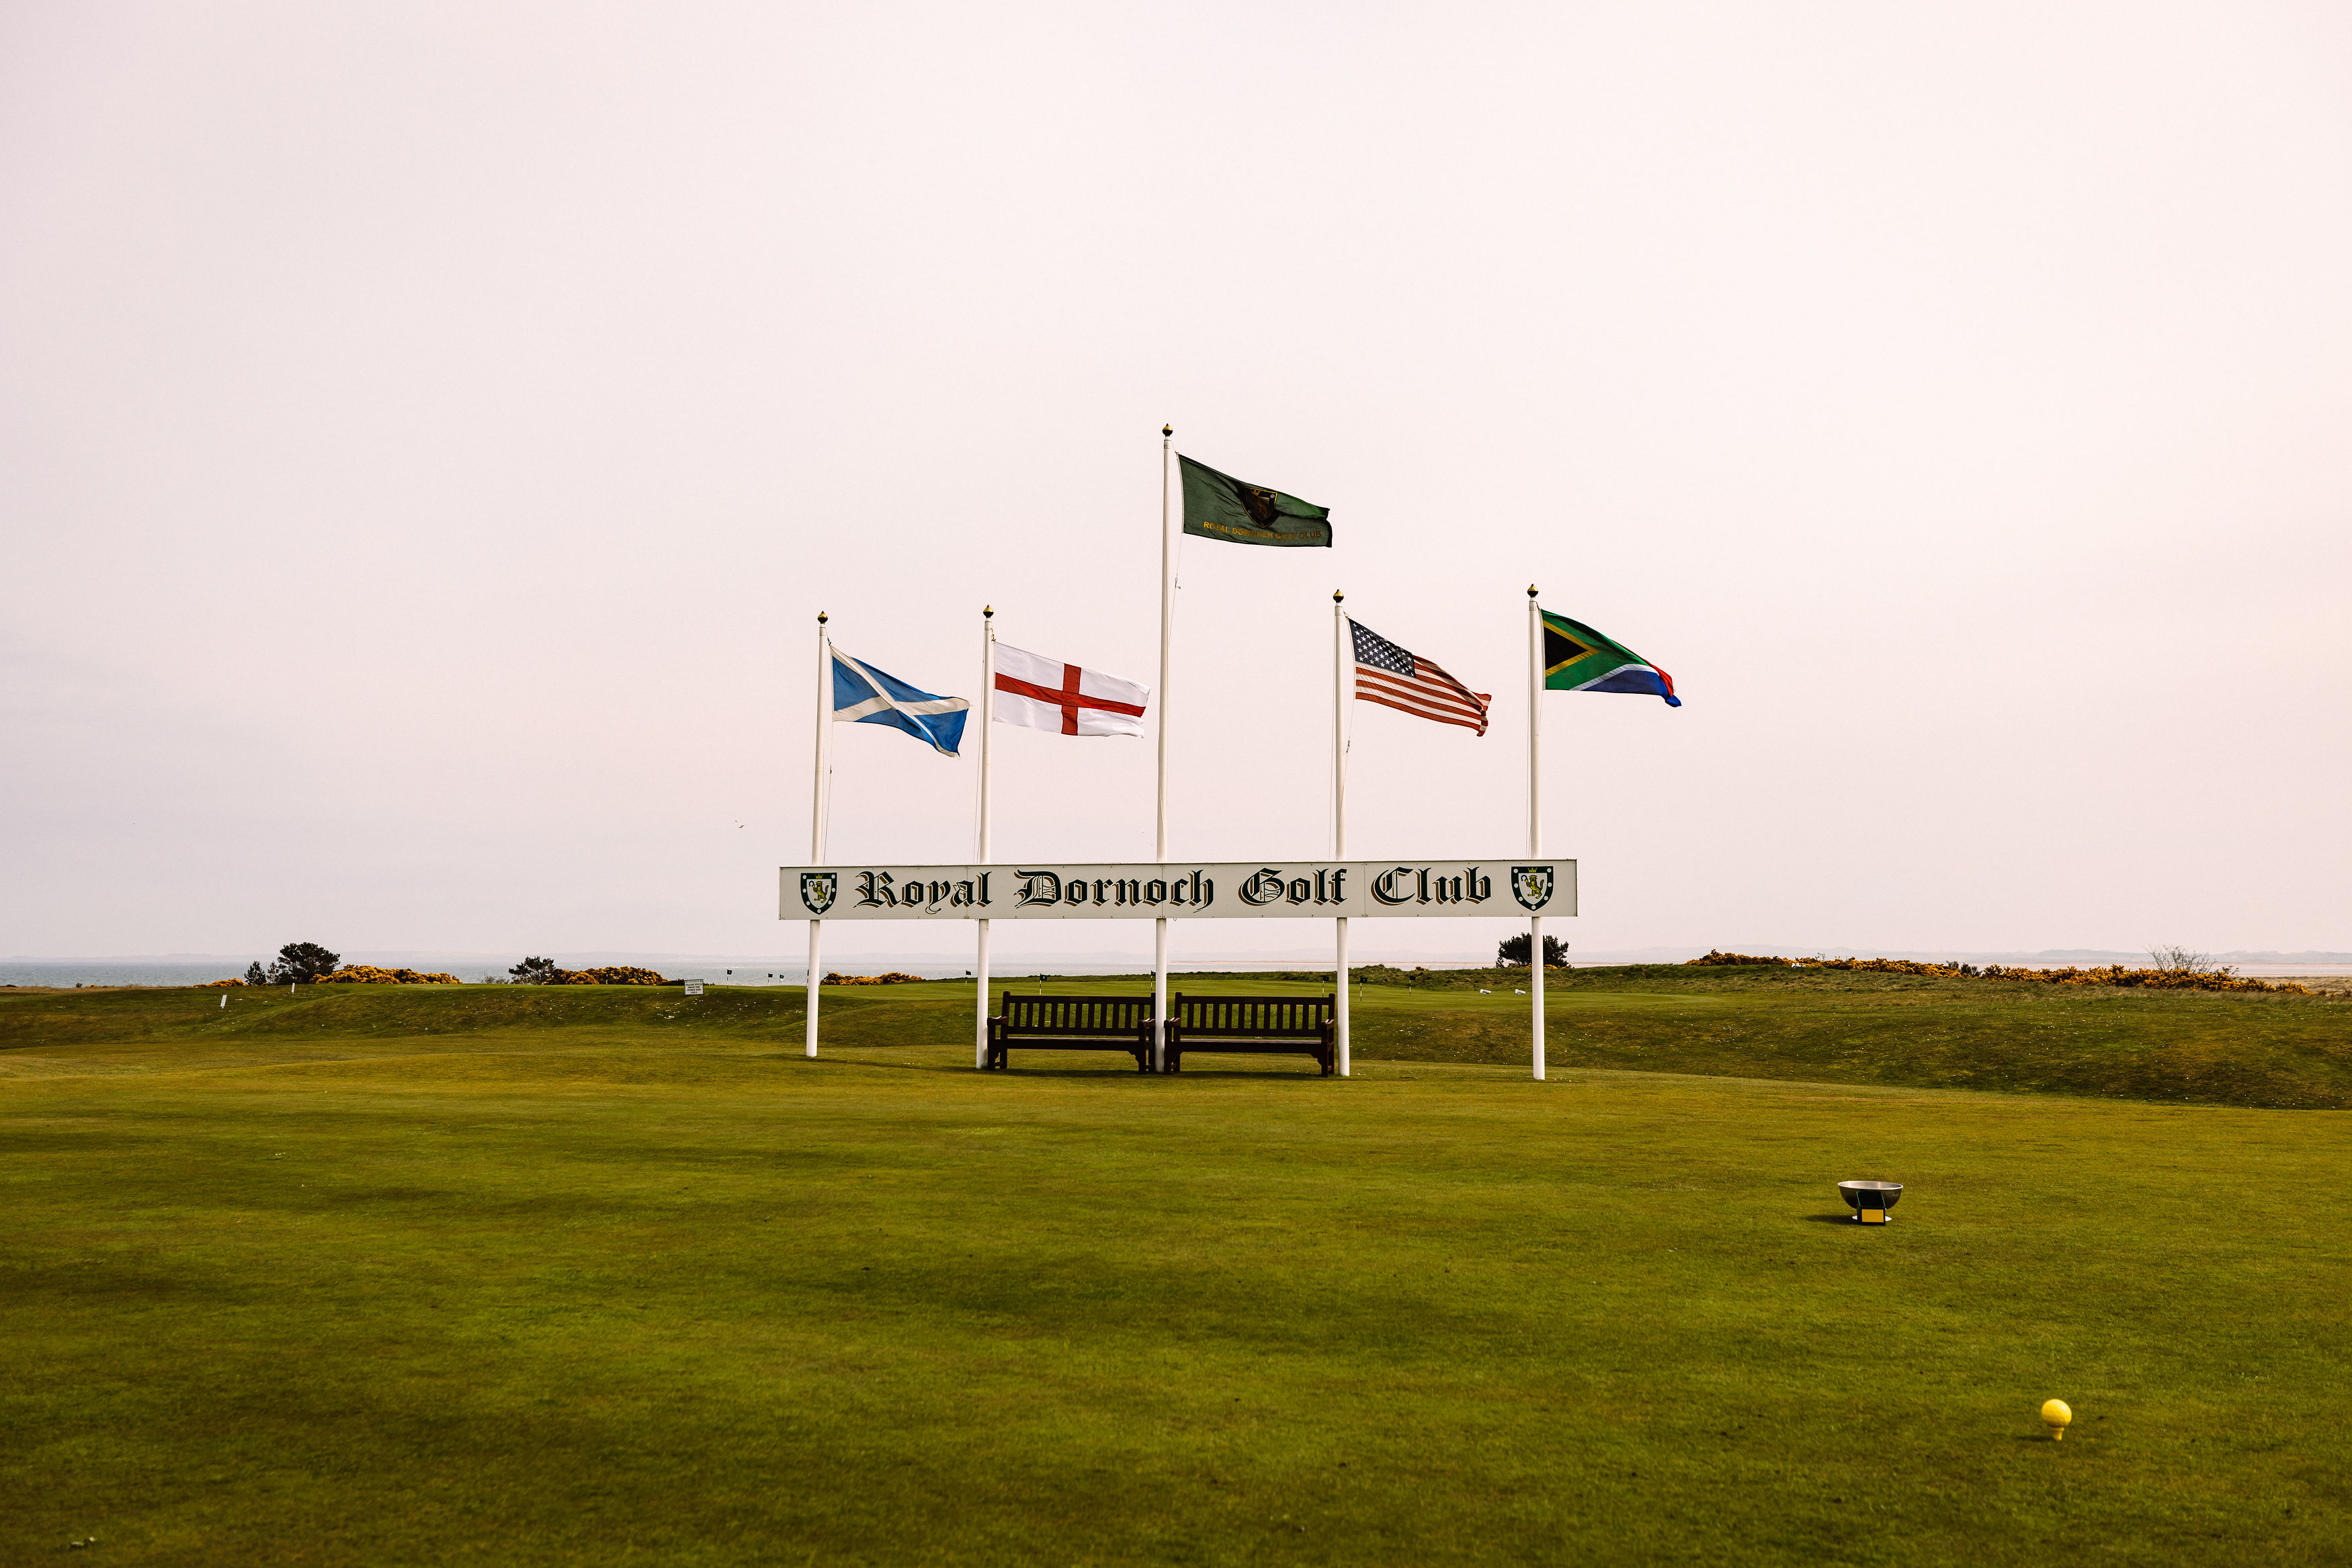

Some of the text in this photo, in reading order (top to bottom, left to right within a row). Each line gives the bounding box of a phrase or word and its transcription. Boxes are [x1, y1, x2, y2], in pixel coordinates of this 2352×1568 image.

[1204, 521, 1322, 540] ROYAL DORNOCH GOLF CLUB
[853, 866, 1491, 914] Royal Dornoch Golf Club
